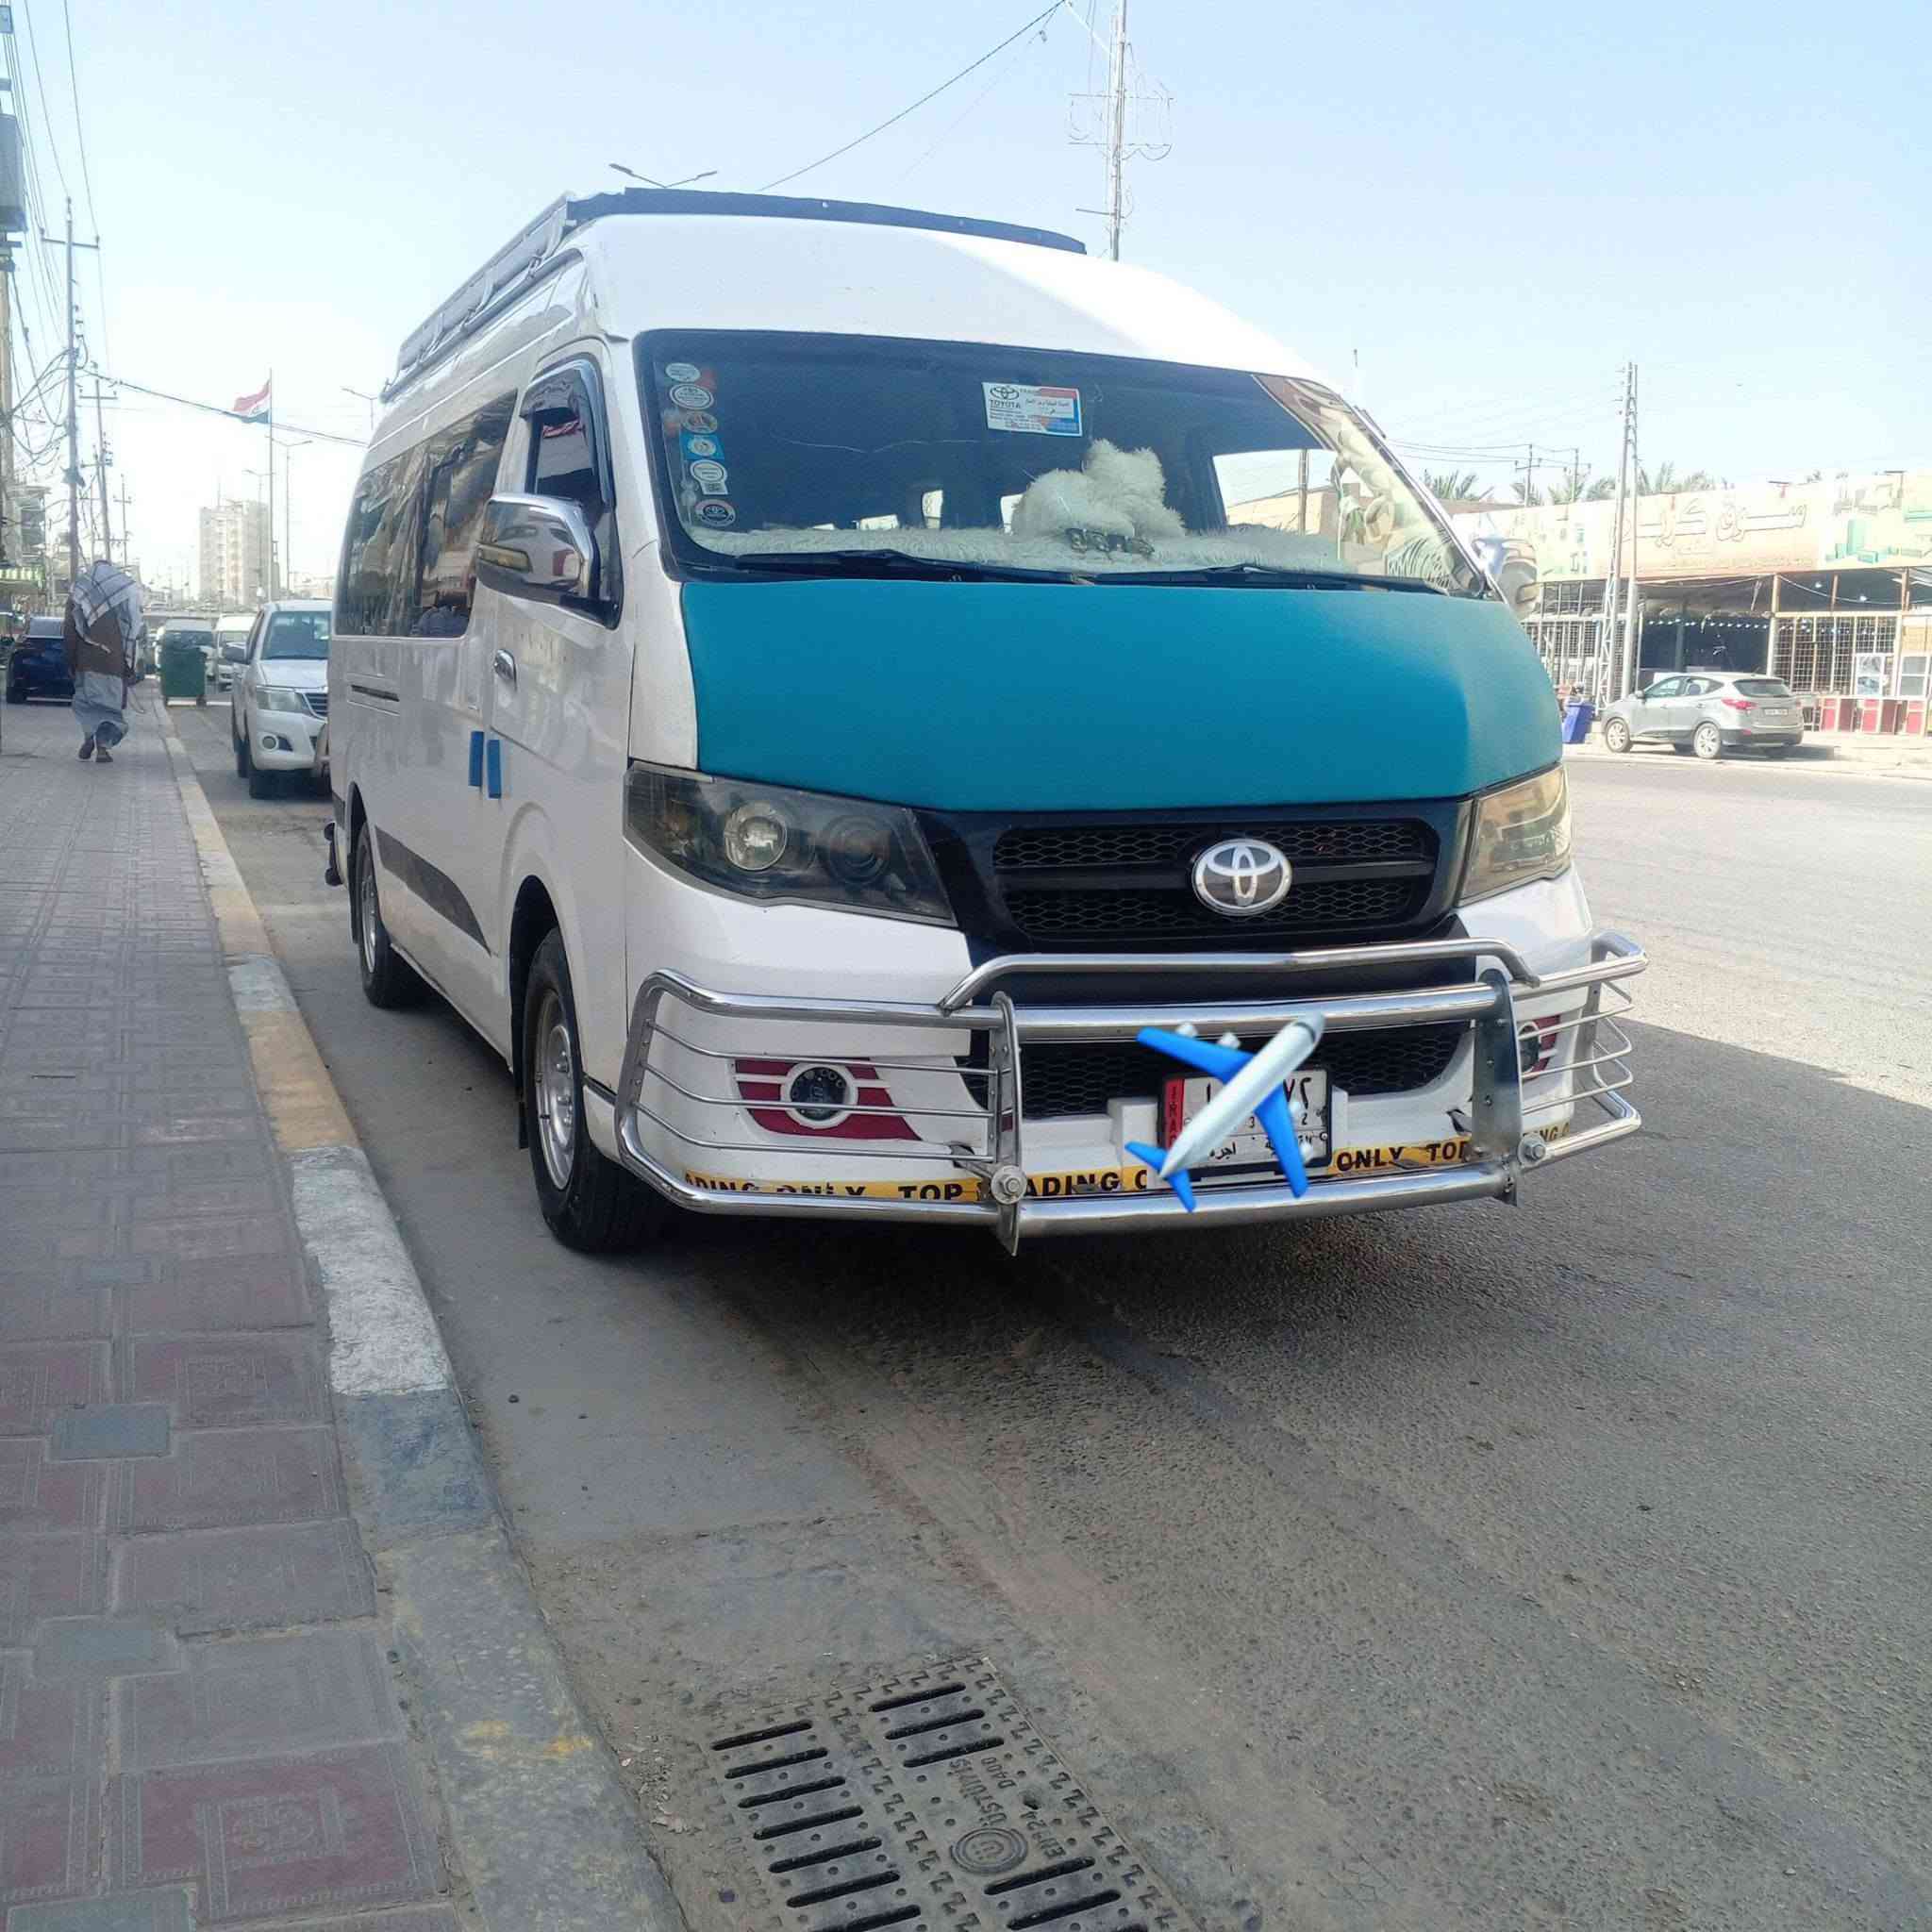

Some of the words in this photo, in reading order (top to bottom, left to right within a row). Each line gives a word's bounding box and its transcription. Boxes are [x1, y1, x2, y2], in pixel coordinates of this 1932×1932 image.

[990, 399, 1021, 409] TOYOTA
[1336, 1146, 1405, 1172] ONLY
[898, 1183, 963, 1201] TOP
